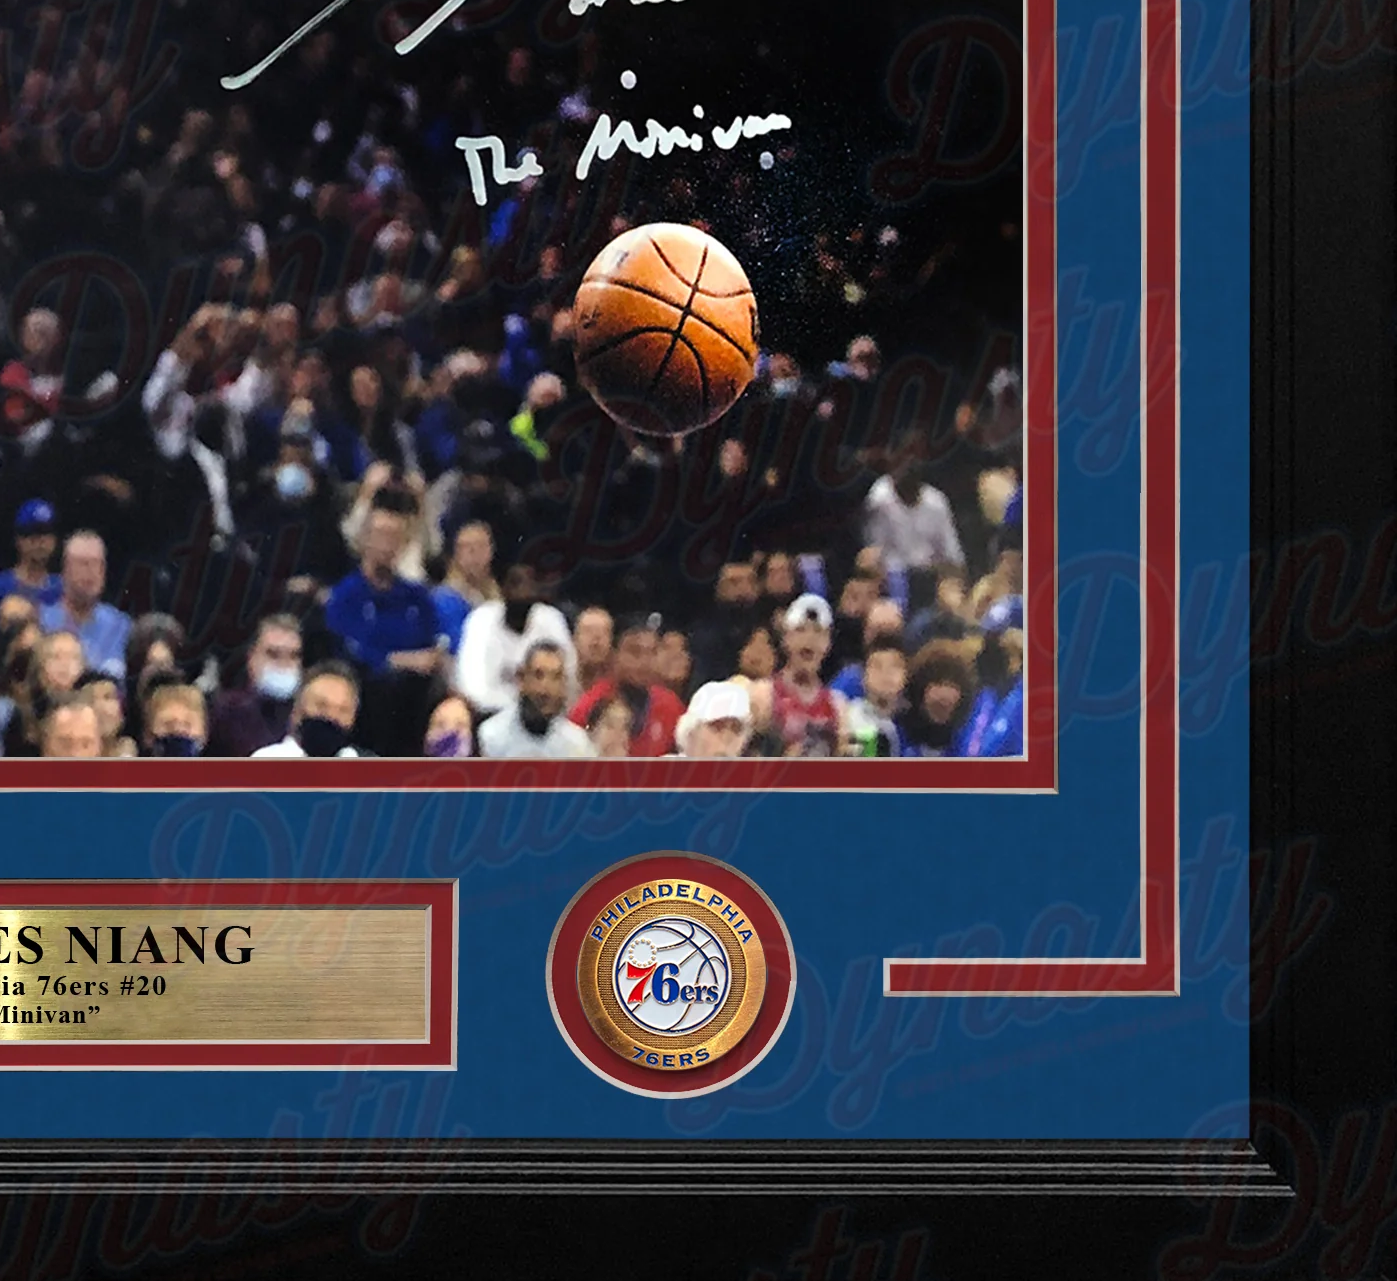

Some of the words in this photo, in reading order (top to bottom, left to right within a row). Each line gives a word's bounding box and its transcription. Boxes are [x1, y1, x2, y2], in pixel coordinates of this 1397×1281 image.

[454, 136, 543, 205] The
[590, 883, 754, 945] PHILADELPHIA
[65, 924, 256, 965] NIANG
[36, 975, 110, 997] 76ers
[120, 975, 167, 997] #20
[625, 961, 720, 1006] 76ers
[631, 1046, 711, 1068] 76ERS
